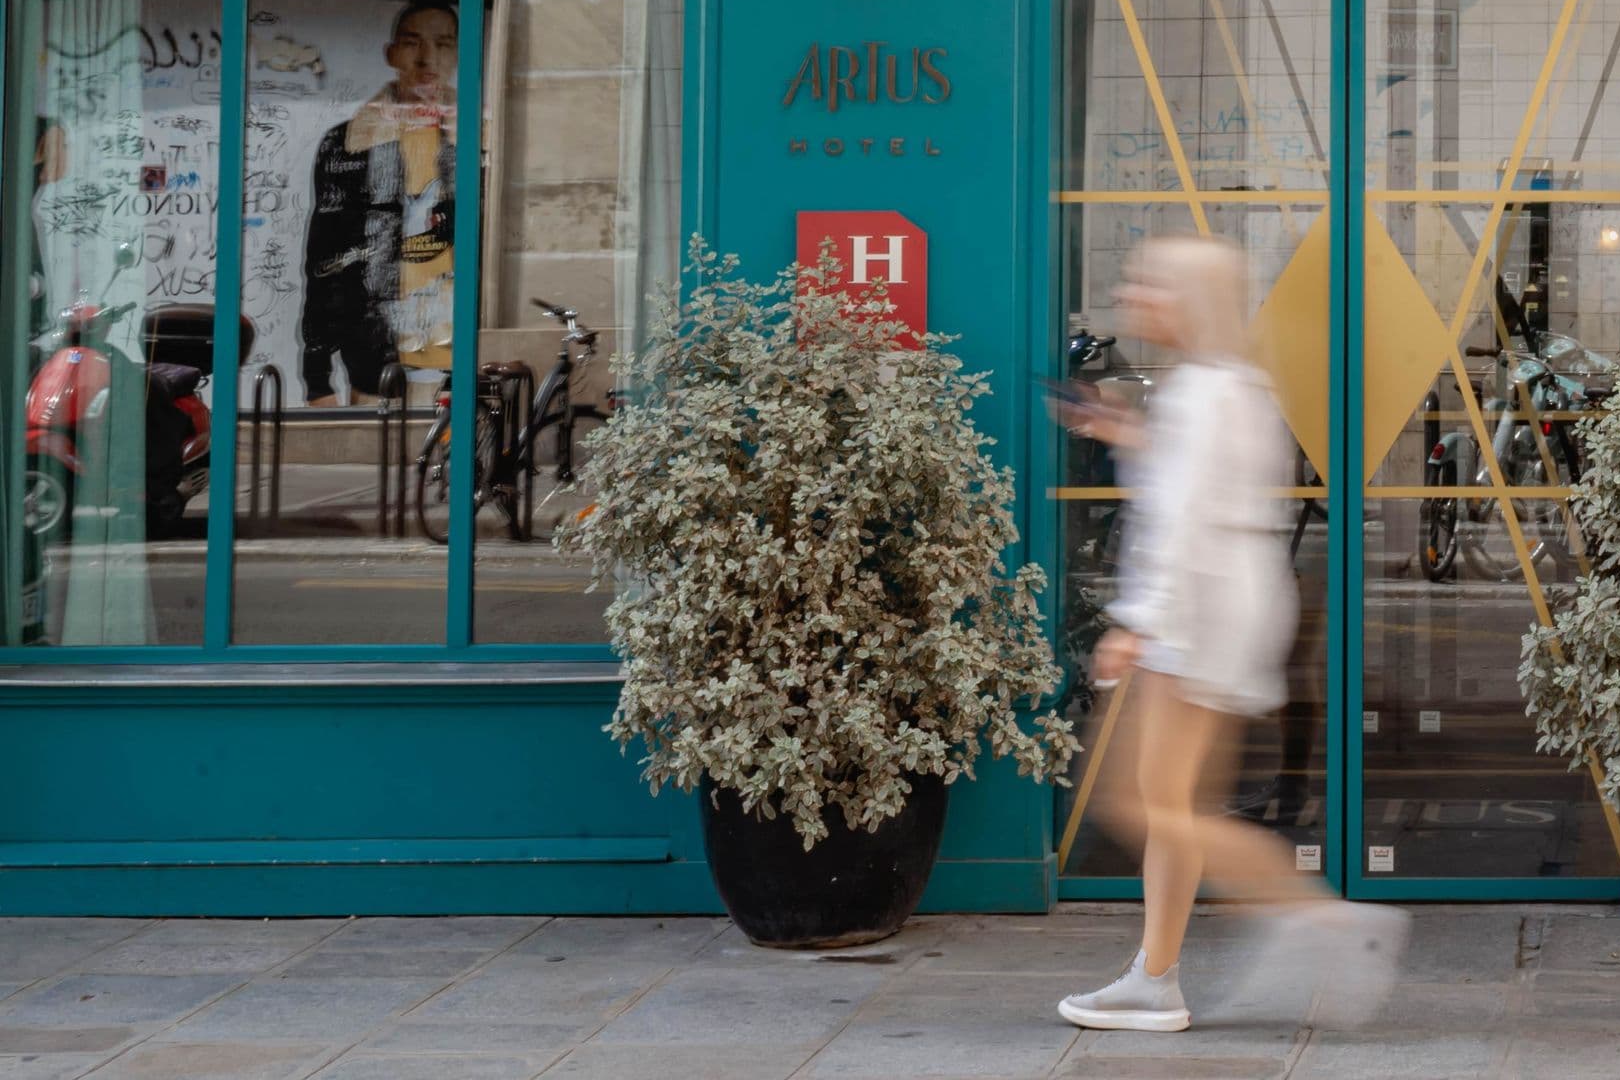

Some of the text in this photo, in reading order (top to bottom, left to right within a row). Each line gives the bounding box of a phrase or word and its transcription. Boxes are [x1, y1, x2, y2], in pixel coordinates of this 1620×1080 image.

[783, 41, 952, 112] ARTUS
[790, 137, 942, 156] HOTEL
[847, 235, 909, 284] H
